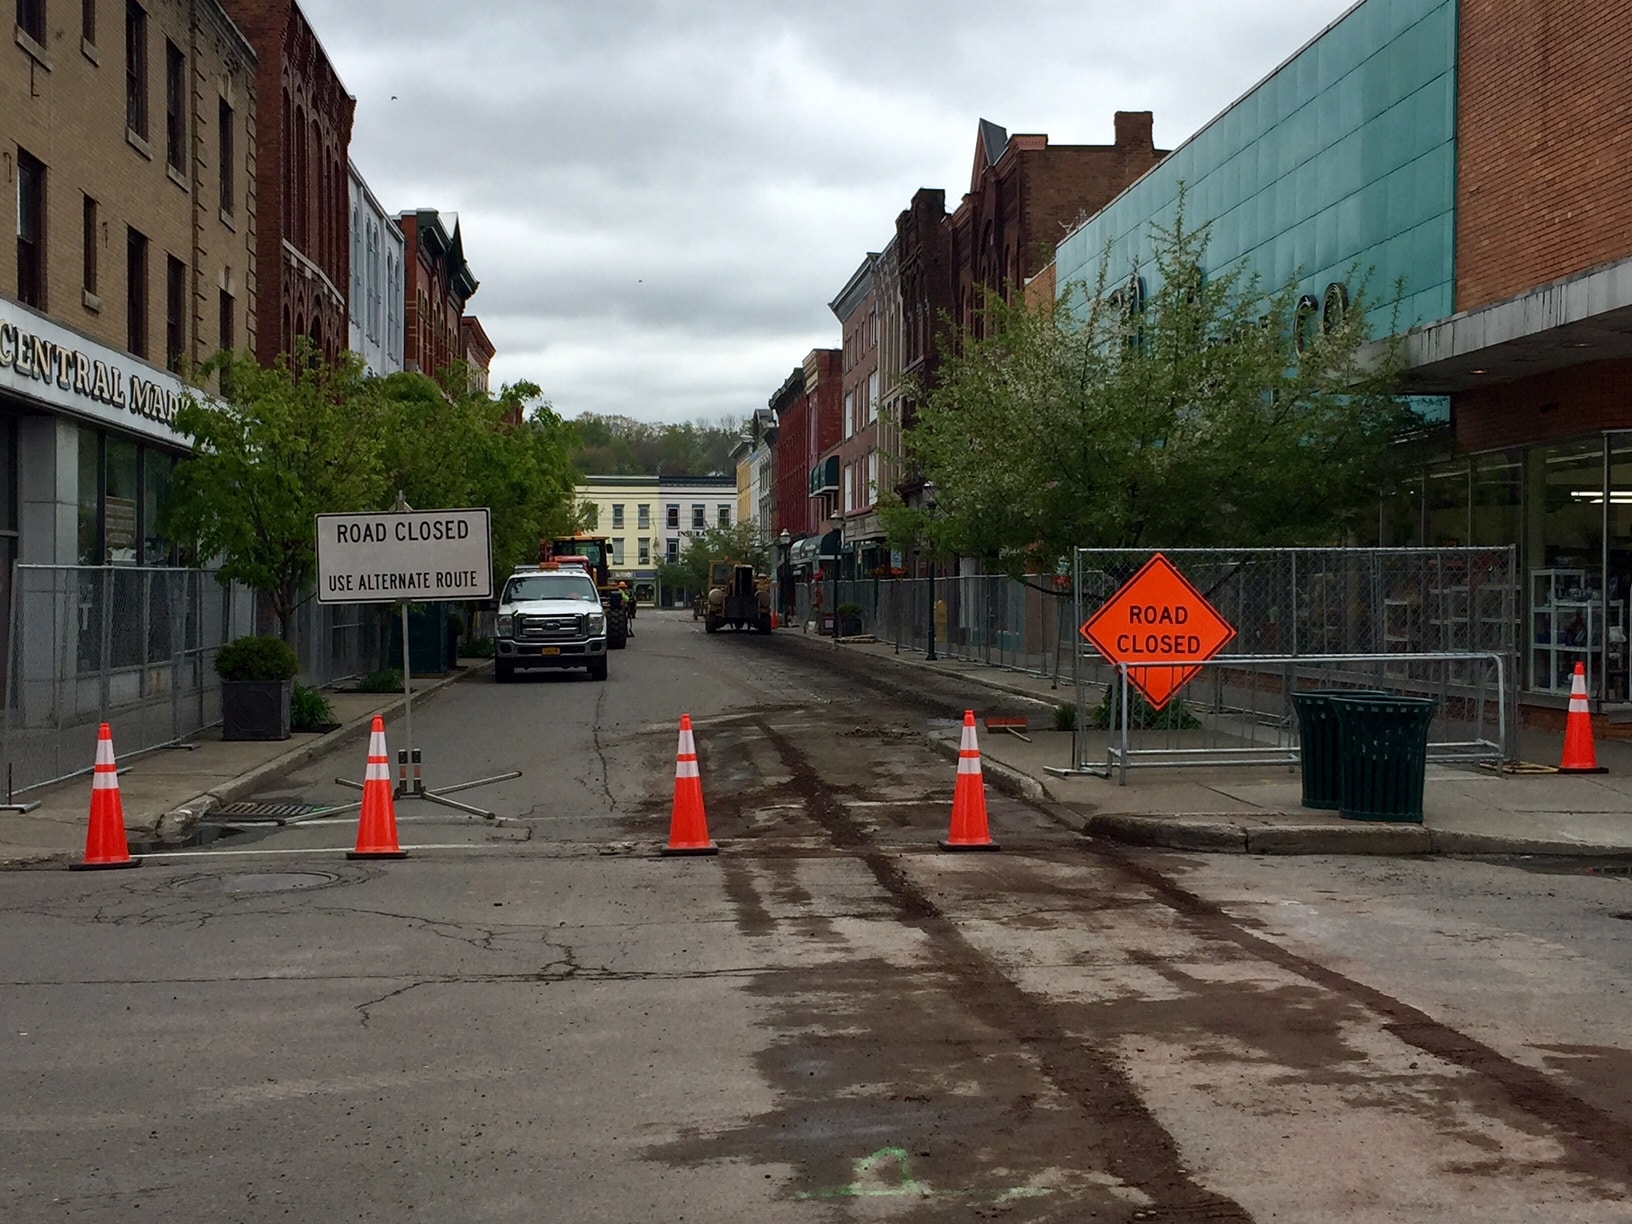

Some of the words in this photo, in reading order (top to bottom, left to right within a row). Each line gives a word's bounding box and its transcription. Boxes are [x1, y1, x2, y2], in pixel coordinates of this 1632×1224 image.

[0, 318, 125, 408] CENTRAL
[337, 522, 387, 543] ROAD
[395, 519, 469, 541] CLOSED
[328, 574, 353, 592] USE
[358, 571, 431, 591] ALTERNATE
[436, 570, 478, 588] ROUTE
[1129, 605, 1188, 625] ROAD
[1117, 634, 1201, 654] CLOSED
